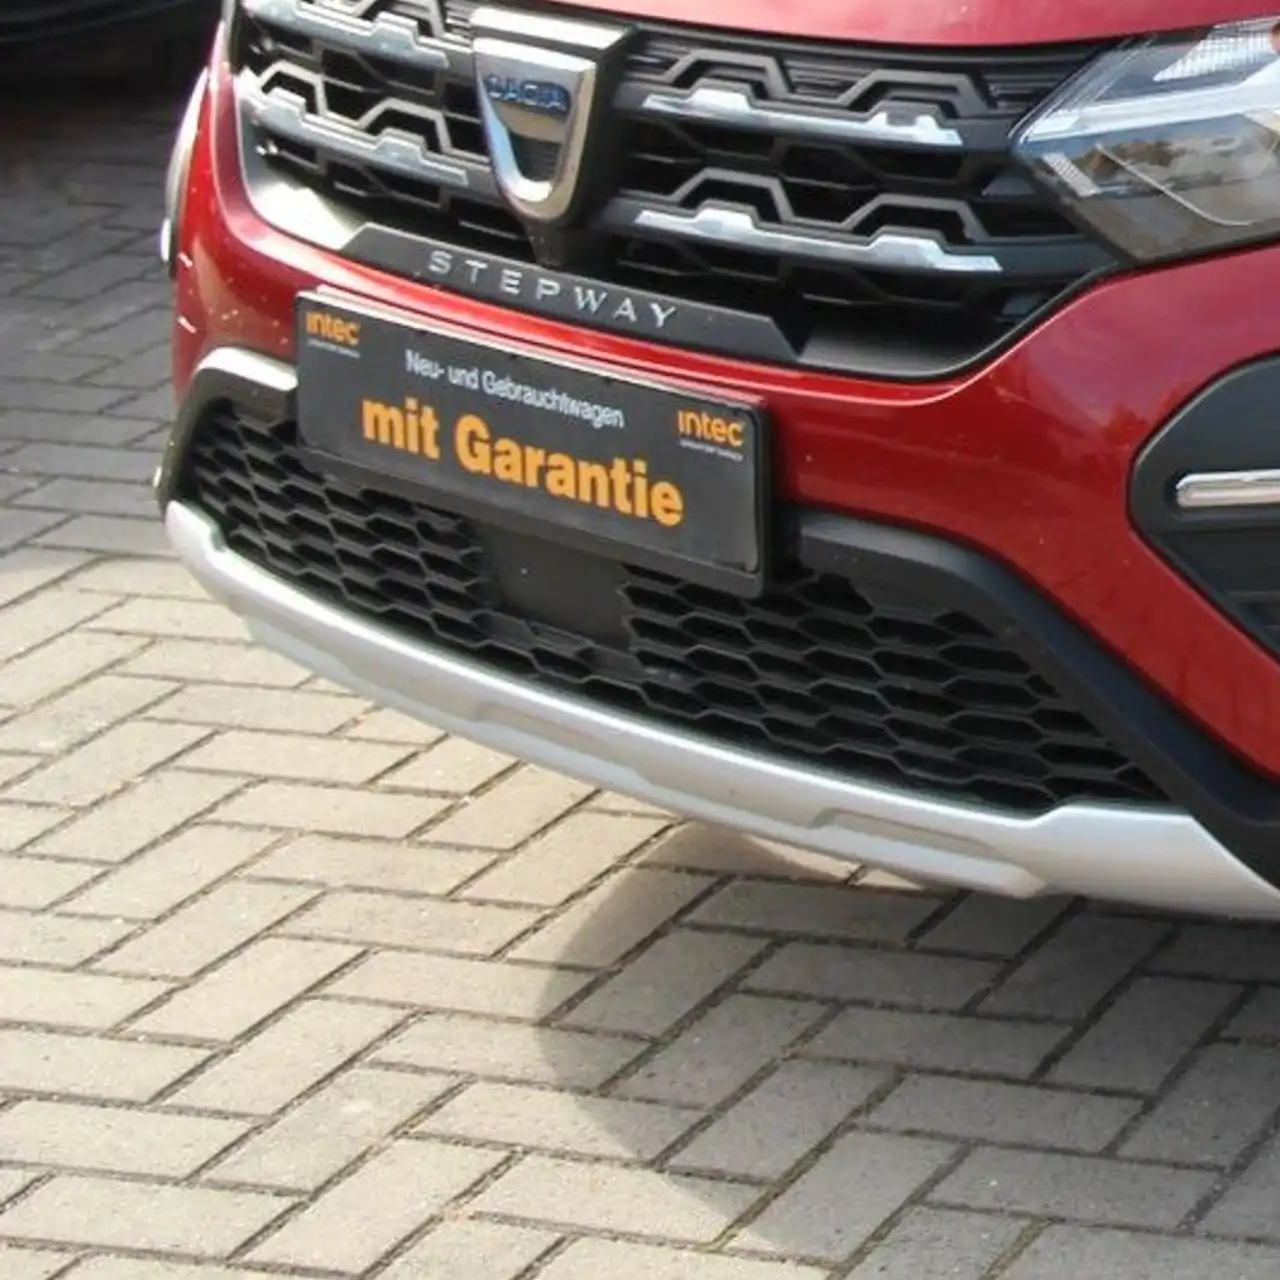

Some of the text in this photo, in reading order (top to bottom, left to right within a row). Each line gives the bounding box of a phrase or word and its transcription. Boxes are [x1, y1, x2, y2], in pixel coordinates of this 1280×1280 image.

[428, 251, 677, 330] STEPWAY
[404, 347, 445, 383] Neu-
[448, 362, 479, 390] und
[482, 370, 625, 429] Gebrauchtwagen
[361, 396, 684, 526] mit Garantie
[677, 409, 746, 448] intec
